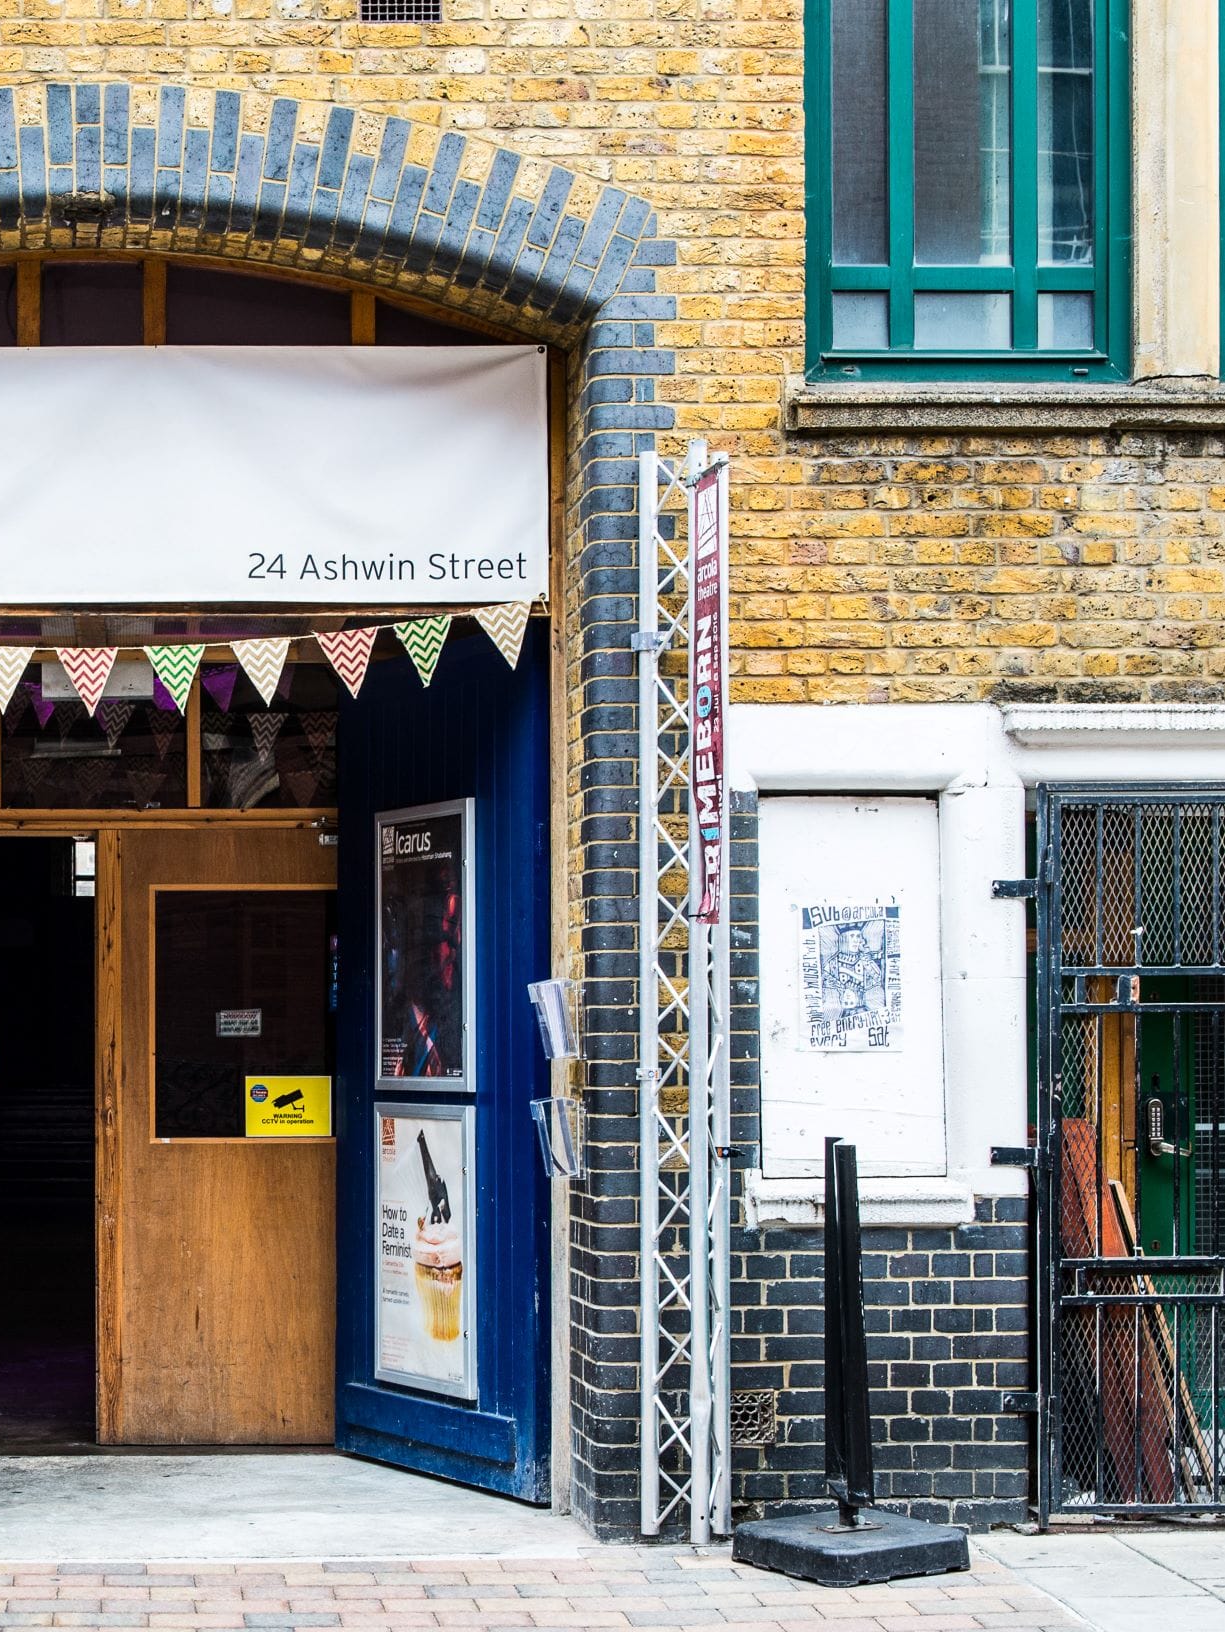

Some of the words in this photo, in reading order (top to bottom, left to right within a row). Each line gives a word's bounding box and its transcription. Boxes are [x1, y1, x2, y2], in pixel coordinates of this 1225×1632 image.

[248, 552, 287, 579] 24
[300, 553, 415, 580] Ashwin
[428, 552, 527, 580] Street
[697, 558, 718, 582] arcola
[697, 581, 718, 601] theatre
[696, 614, 721, 910] RIMEBORN
[396, 831, 431, 855] Icarus
[382, 1204, 398, 1220] How
[399, 1206, 408, 1221] to
[382, 1222, 399, 1239] Date
[400, 1227, 405, 1239] a
